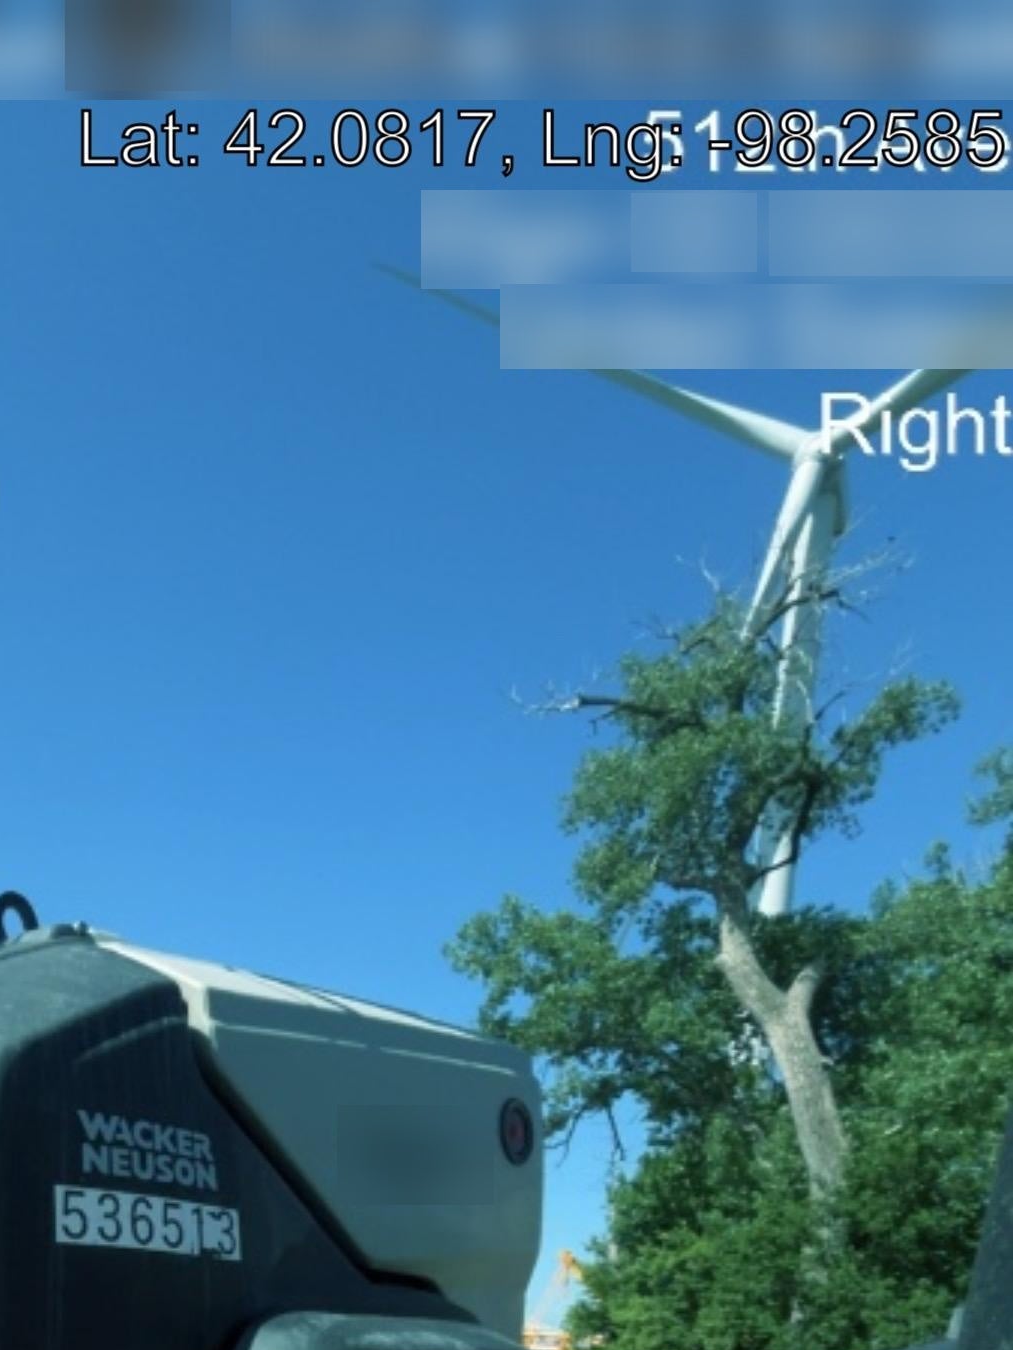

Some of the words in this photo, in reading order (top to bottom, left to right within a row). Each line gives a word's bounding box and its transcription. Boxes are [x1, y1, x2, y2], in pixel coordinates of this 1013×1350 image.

[76, 1109, 214, 1161] WACKER
[82, 1142, 219, 1191] NEUSON
[60, 1190, 237, 1255] 536513
